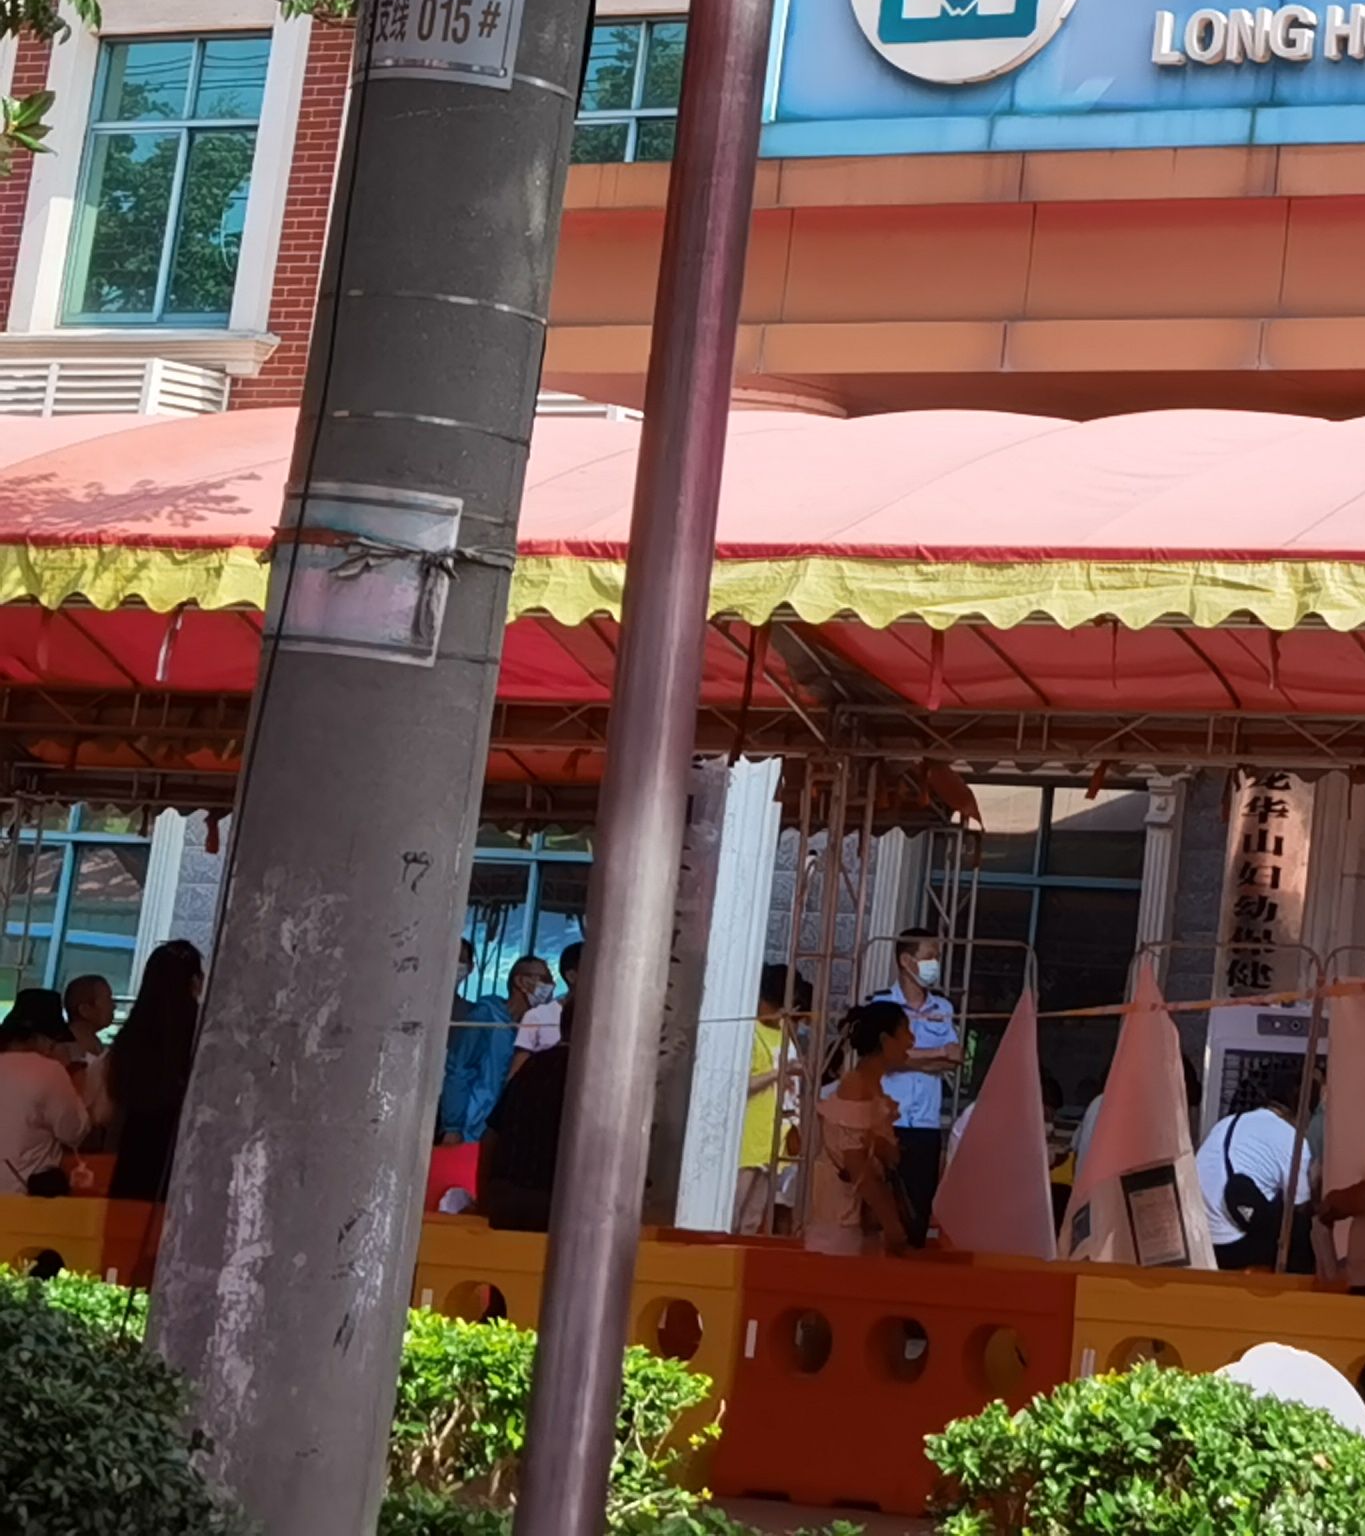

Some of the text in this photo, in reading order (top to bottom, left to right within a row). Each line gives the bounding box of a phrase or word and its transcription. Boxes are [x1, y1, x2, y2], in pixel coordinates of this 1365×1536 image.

[1227, 771, 1290, 996] 龙华山妇幼保健
